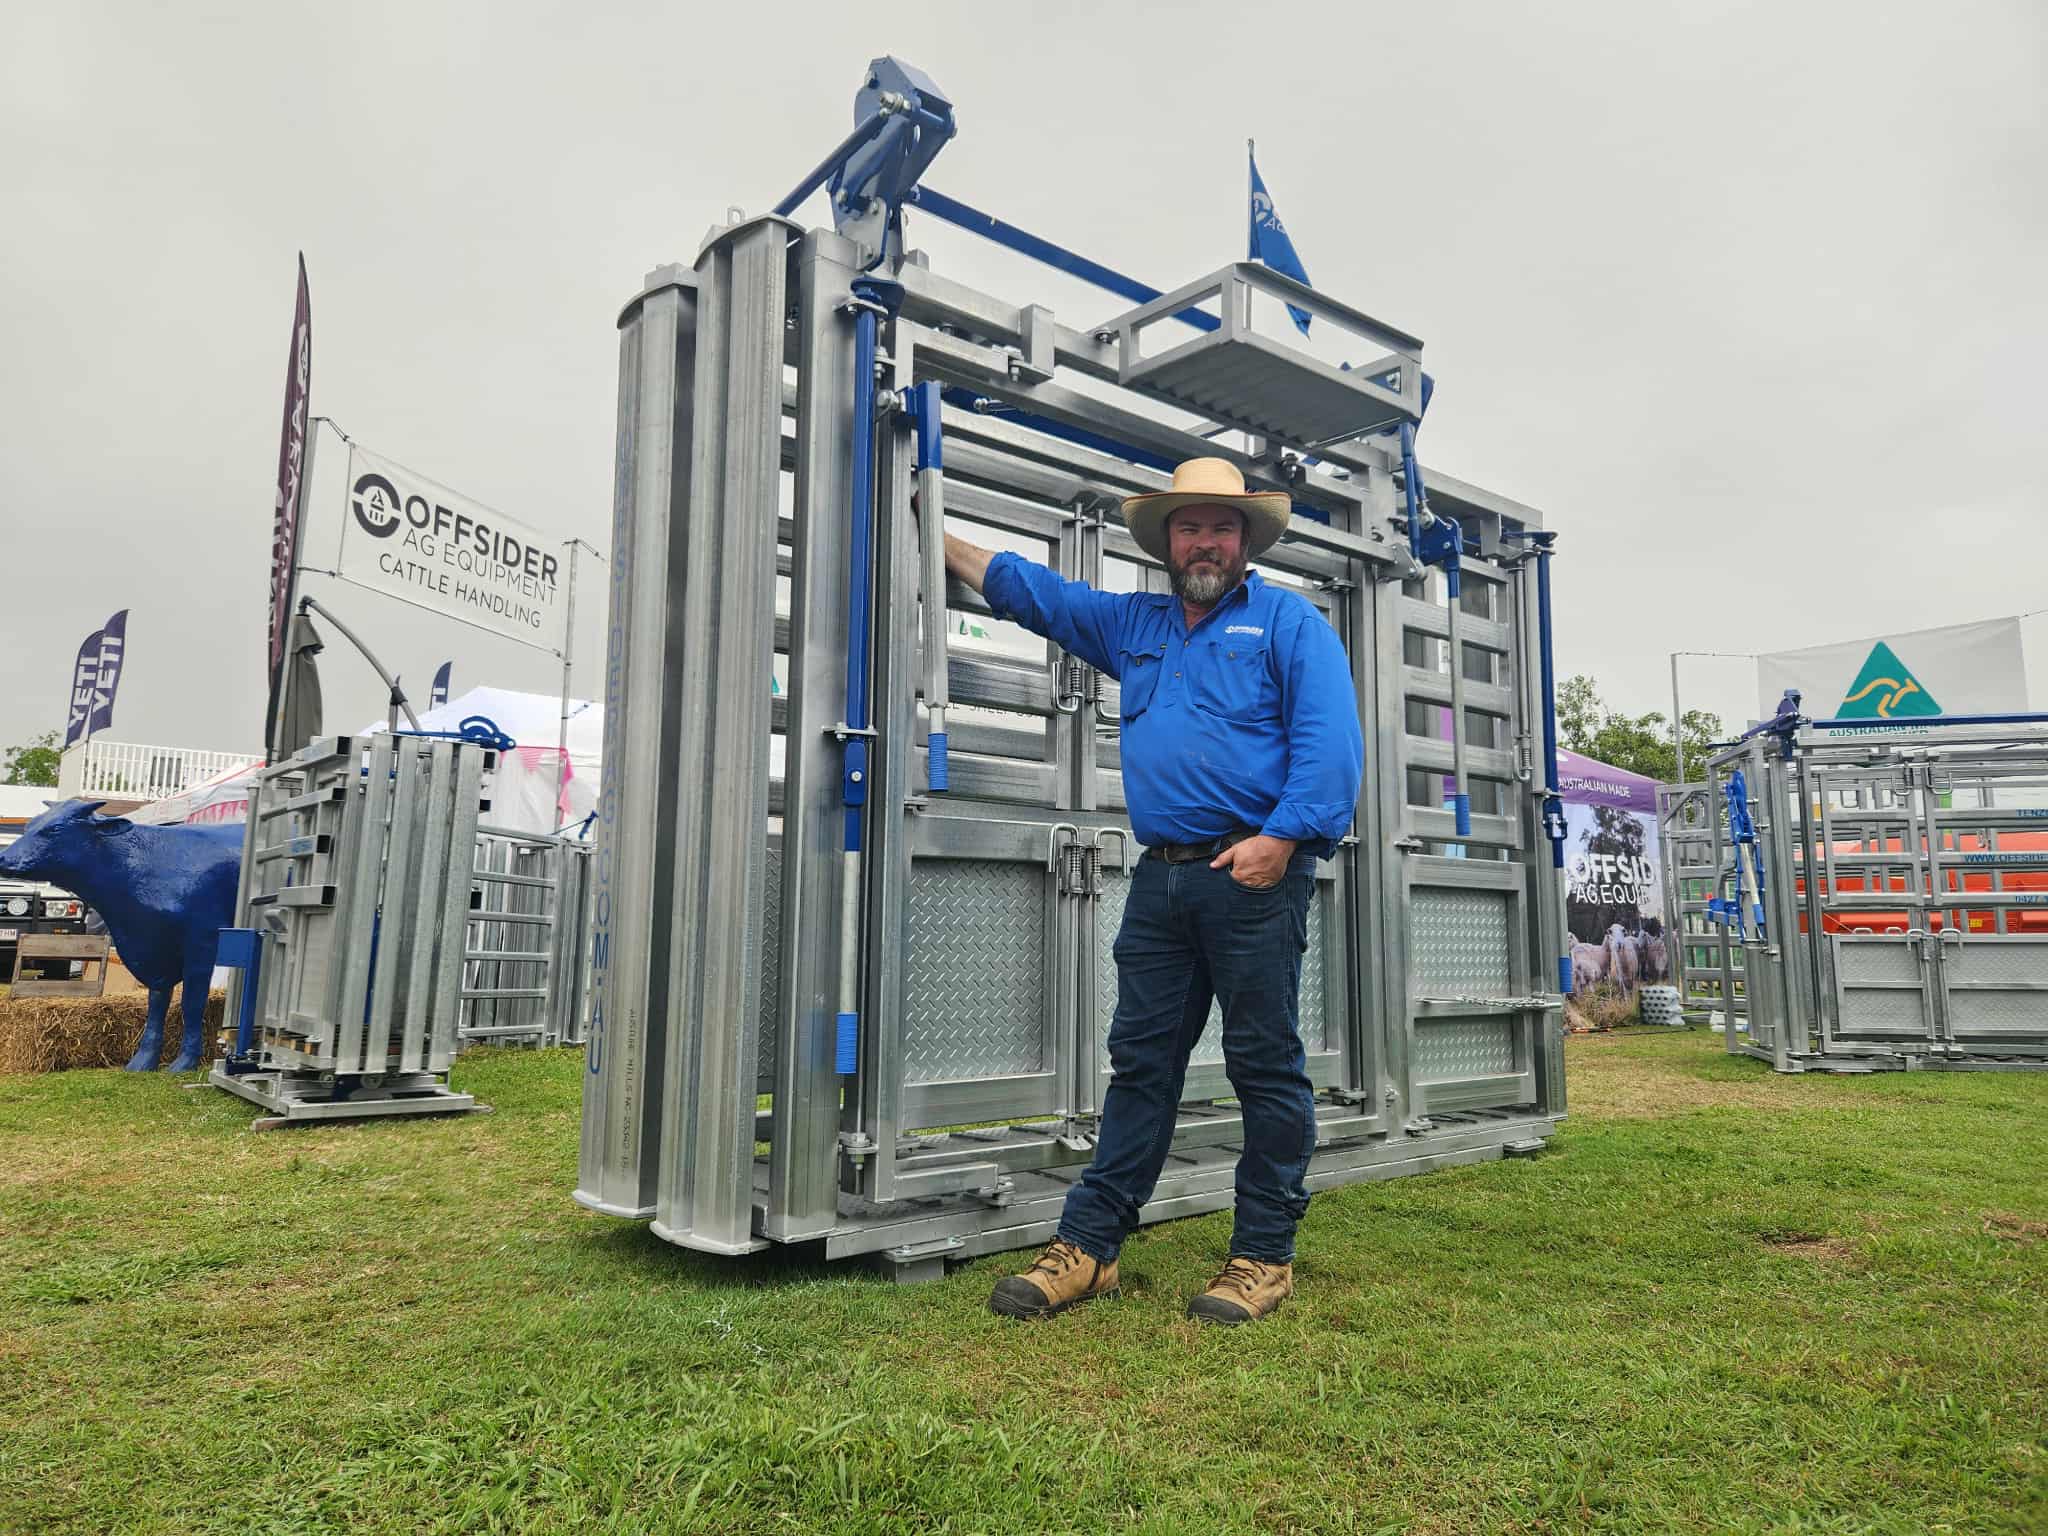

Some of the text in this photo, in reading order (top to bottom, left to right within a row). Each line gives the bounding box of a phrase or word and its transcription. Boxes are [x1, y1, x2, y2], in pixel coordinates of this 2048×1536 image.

[402, 528, 557, 606] AG EQUIPMENT
[405, 495, 558, 586] OFFSIDER
[379, 553, 541, 629] CATTLE HANDLING
[69, 656, 99, 729] YETI
[92, 636, 122, 713] YETI
[1558, 777, 1631, 798] AUSTRALIAN MADE
[1576, 884, 1598, 904] AG
